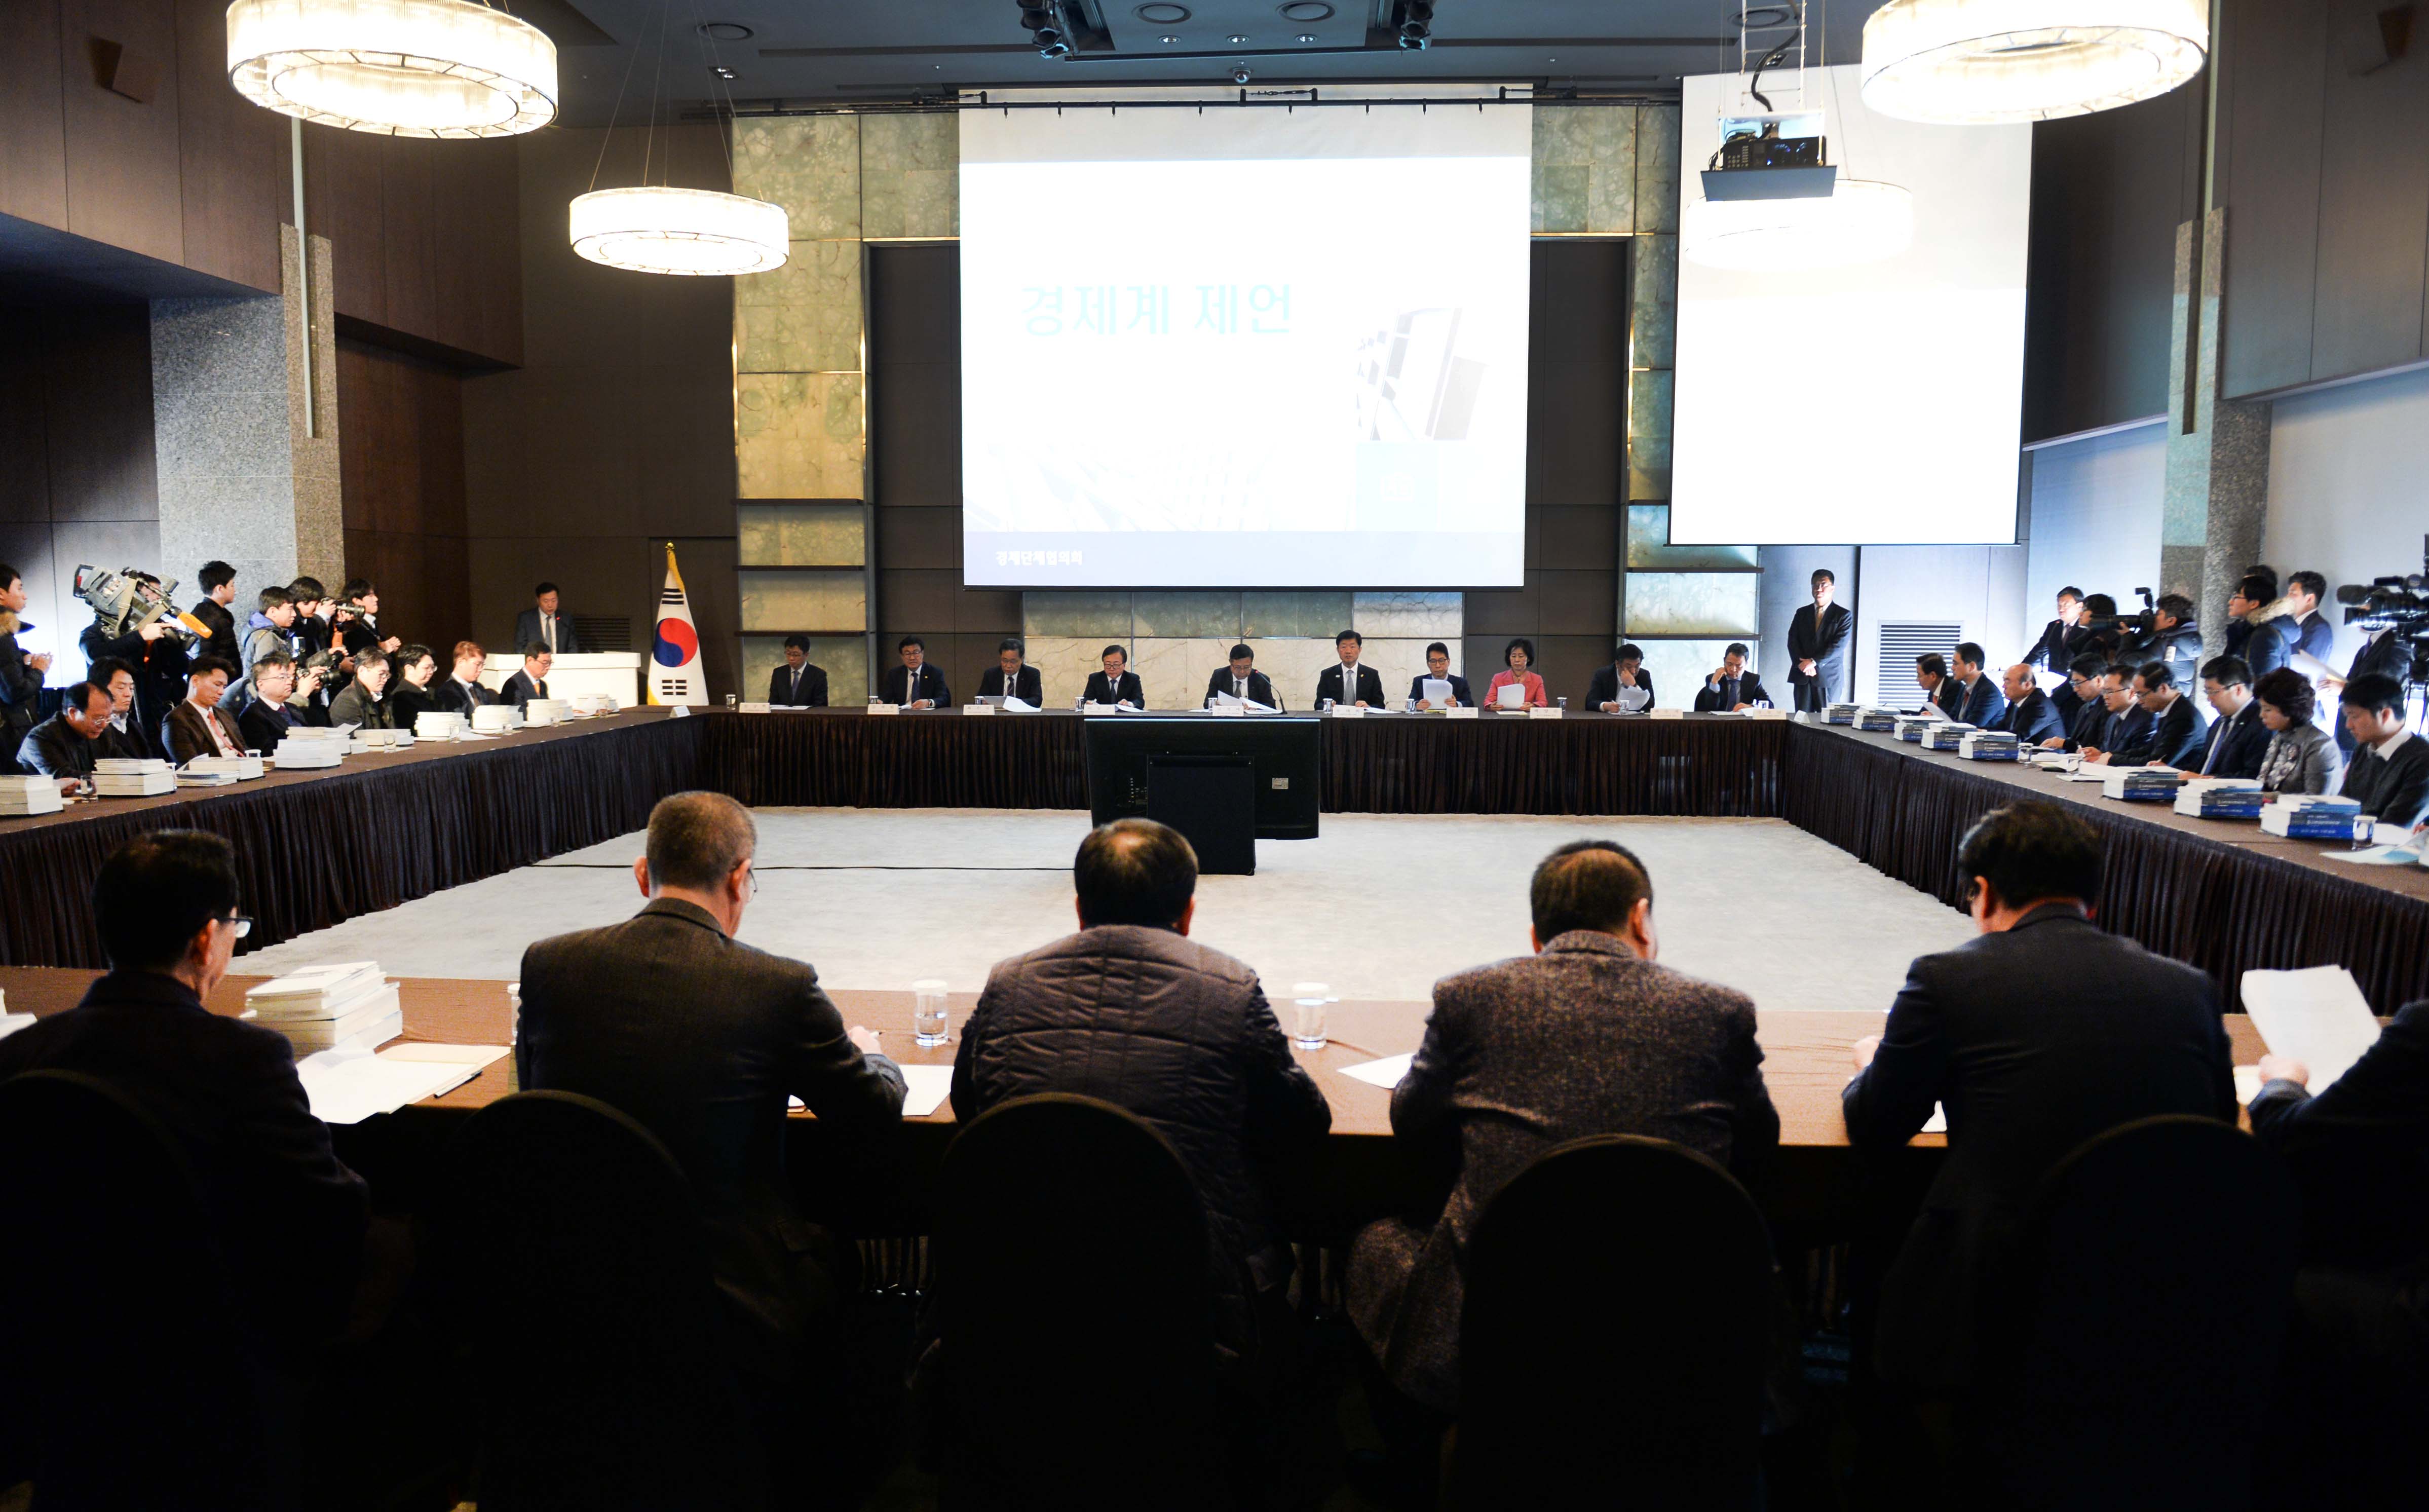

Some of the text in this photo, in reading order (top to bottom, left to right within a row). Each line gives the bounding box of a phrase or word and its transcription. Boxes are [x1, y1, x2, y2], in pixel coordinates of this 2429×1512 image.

[1023, 284, 1290, 335] 경제계 제언
[996, 551, 1082, 565] 경제단체협의회
